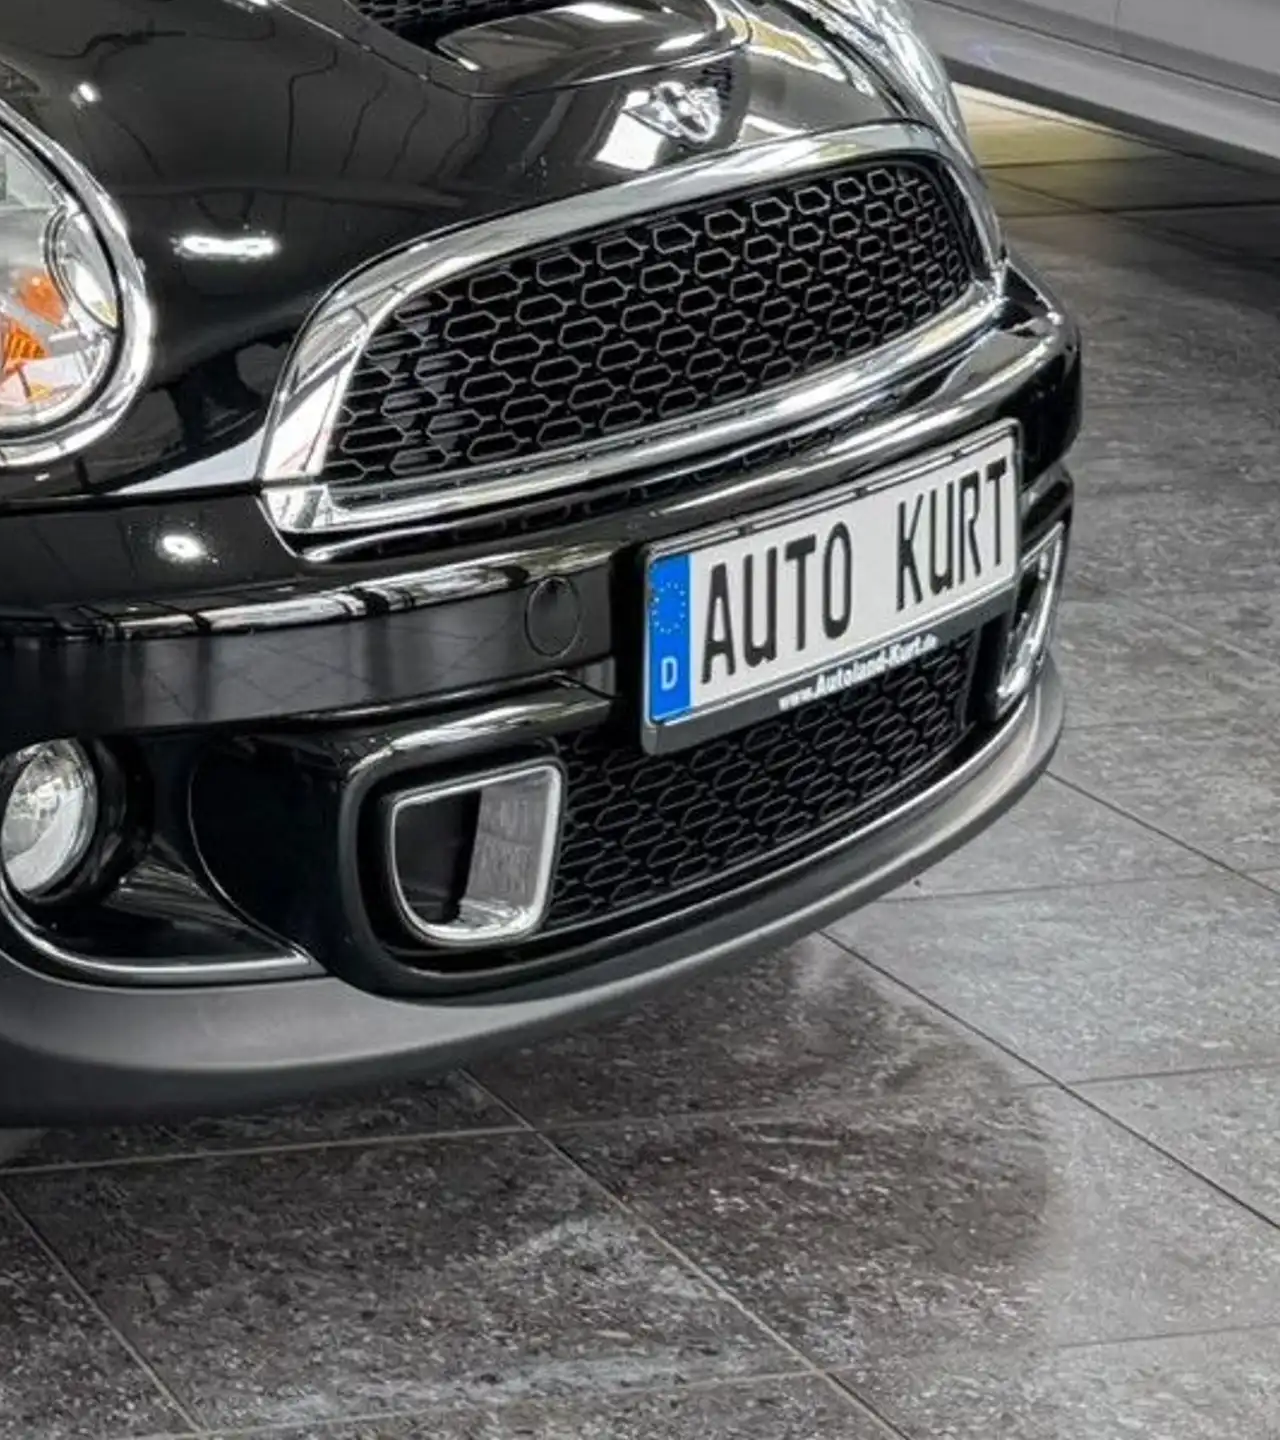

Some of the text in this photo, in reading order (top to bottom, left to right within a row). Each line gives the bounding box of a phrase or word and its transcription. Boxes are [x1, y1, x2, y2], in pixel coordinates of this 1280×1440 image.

[661, 456, 1007, 691] D AUTO KURT
